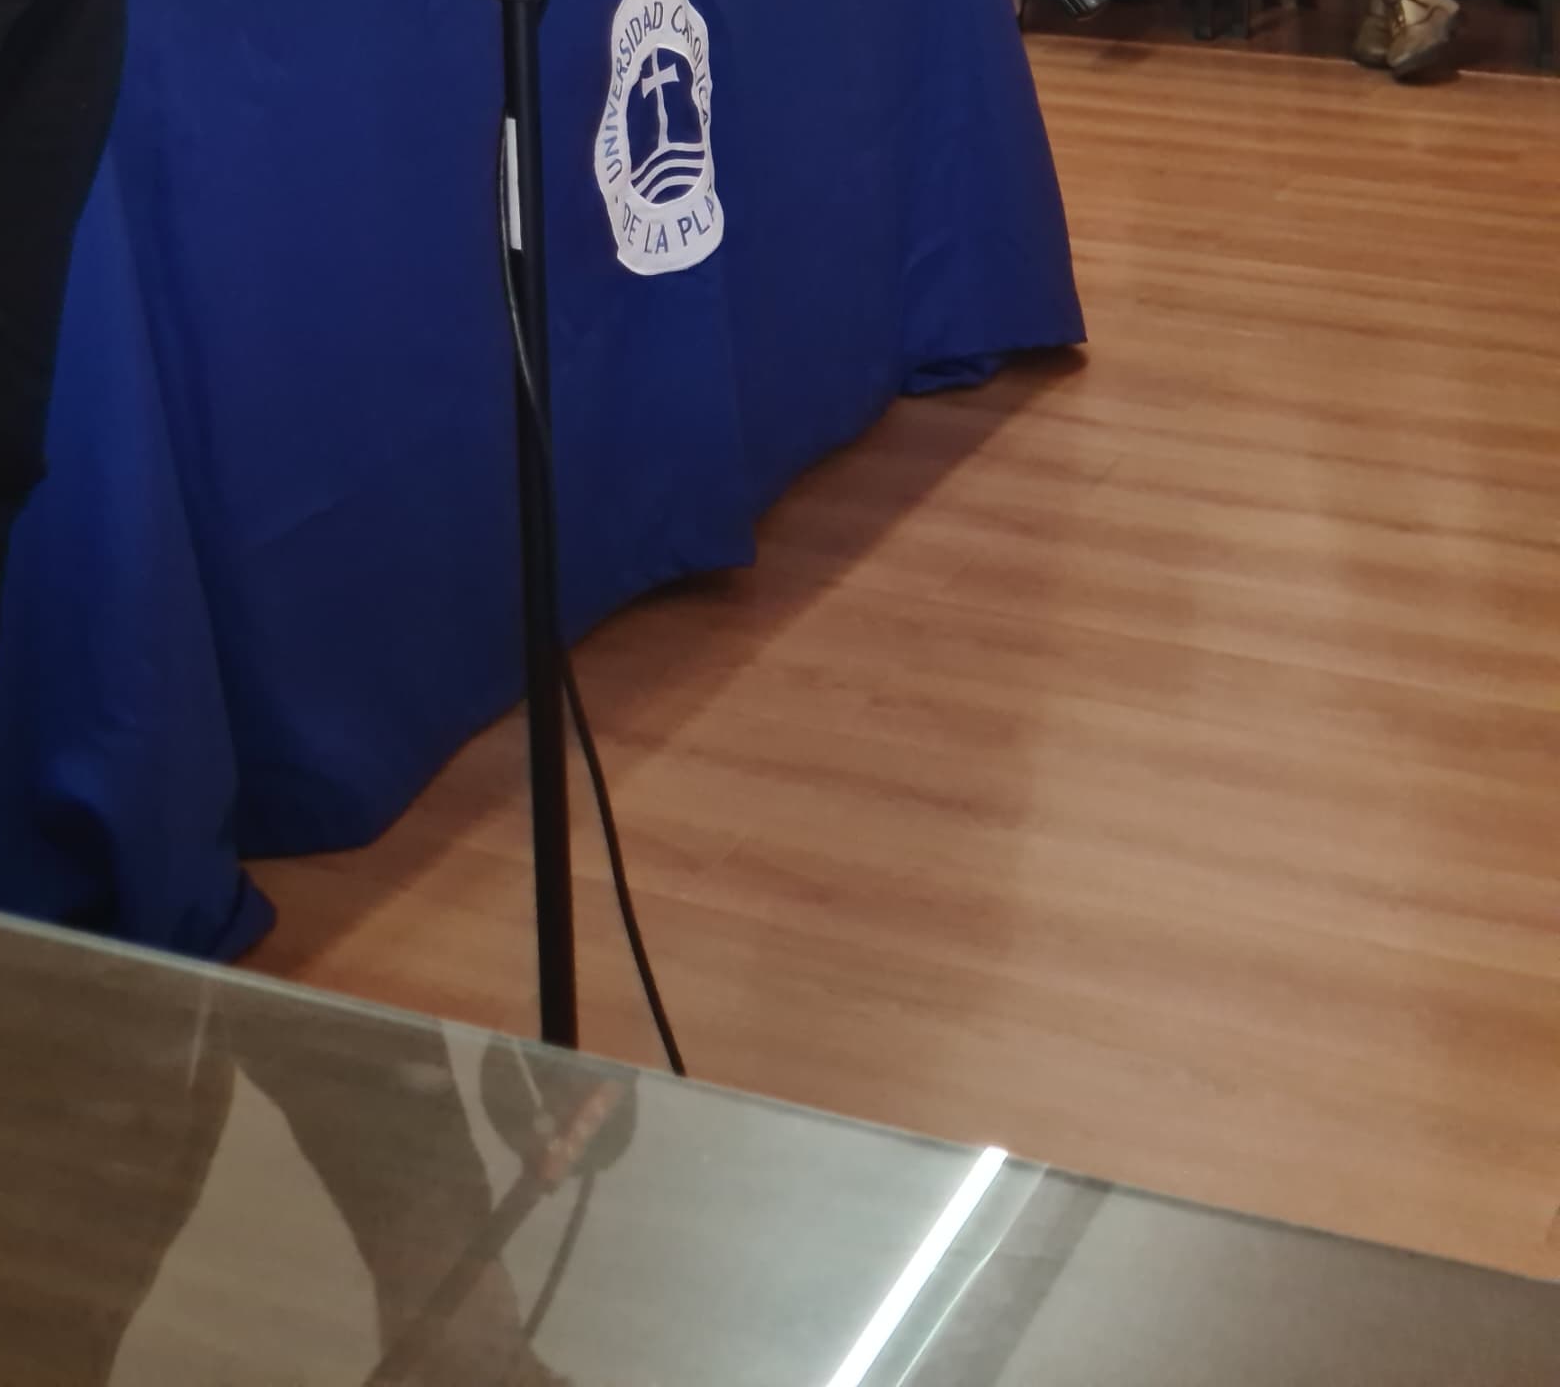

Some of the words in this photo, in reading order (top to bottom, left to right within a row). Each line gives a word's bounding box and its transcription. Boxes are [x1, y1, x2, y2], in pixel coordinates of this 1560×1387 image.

[603, 0, 664, 185] UNIVERSIDAD
[622, 202, 643, 246] DE
[643, 221, 670, 255] LA
[676, 183, 716, 247] PLA
